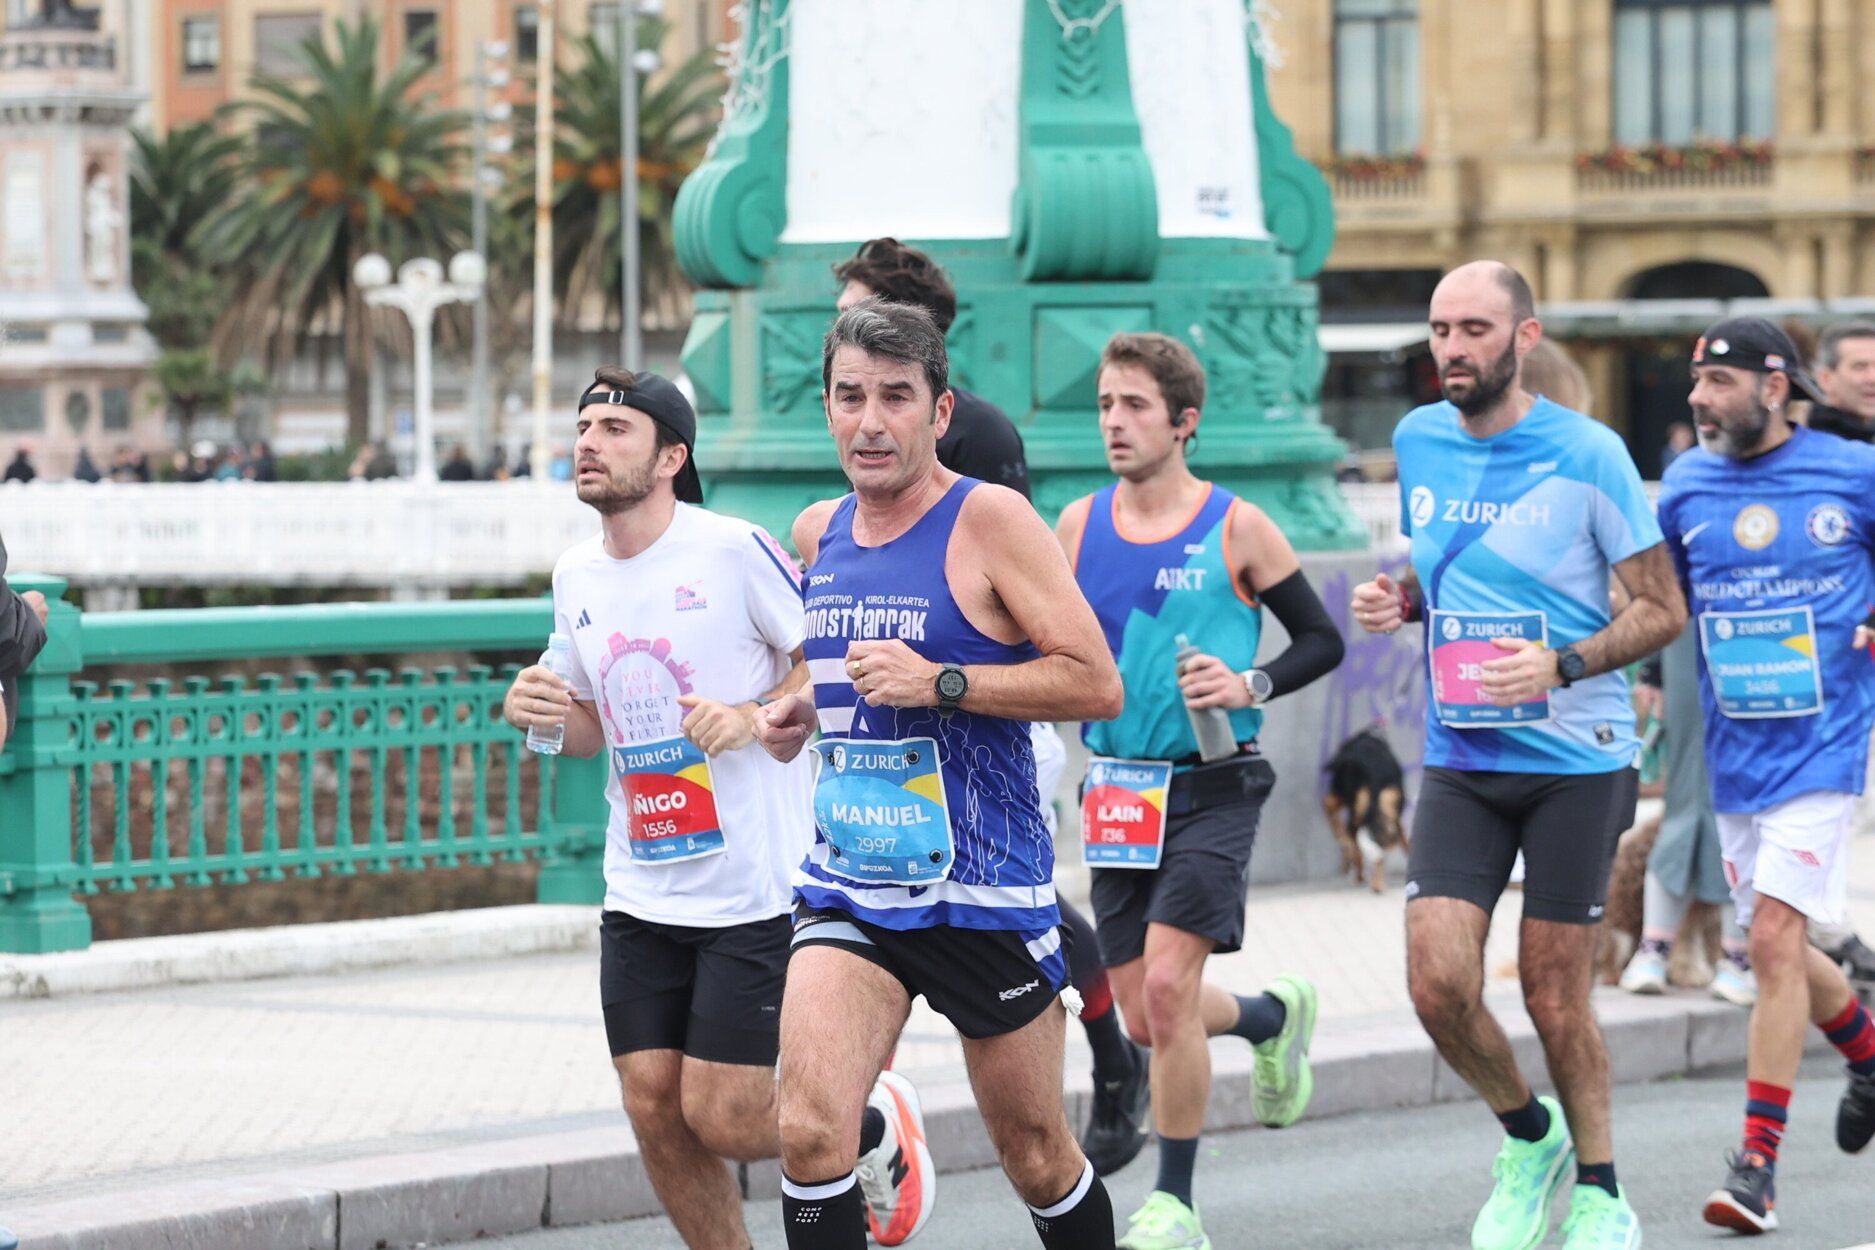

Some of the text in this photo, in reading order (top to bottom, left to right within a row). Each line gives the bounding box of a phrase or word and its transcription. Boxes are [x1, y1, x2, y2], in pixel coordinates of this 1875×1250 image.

[1442, 499, 1550, 526] ZURICH
[813, 594, 853, 606] DEPORTIVO
[865, 594, 930, 608] KIROL-ELKARTEA
[1466, 623, 1524, 637] ZURICH
[1737, 619, 1792, 635] ZURICH
[623, 669, 652, 682] YOU
[621, 695, 669, 713] ORGET
[626, 712, 663, 726] YOUR
[629, 727, 665, 741] FIRT
[626, 746, 683, 769] ZURICH
[851, 753, 910, 771] ZURICH
[832, 801, 931, 827] MANUEL
[642, 818, 677, 838] 1556
[855, 837, 897, 854] 2997
